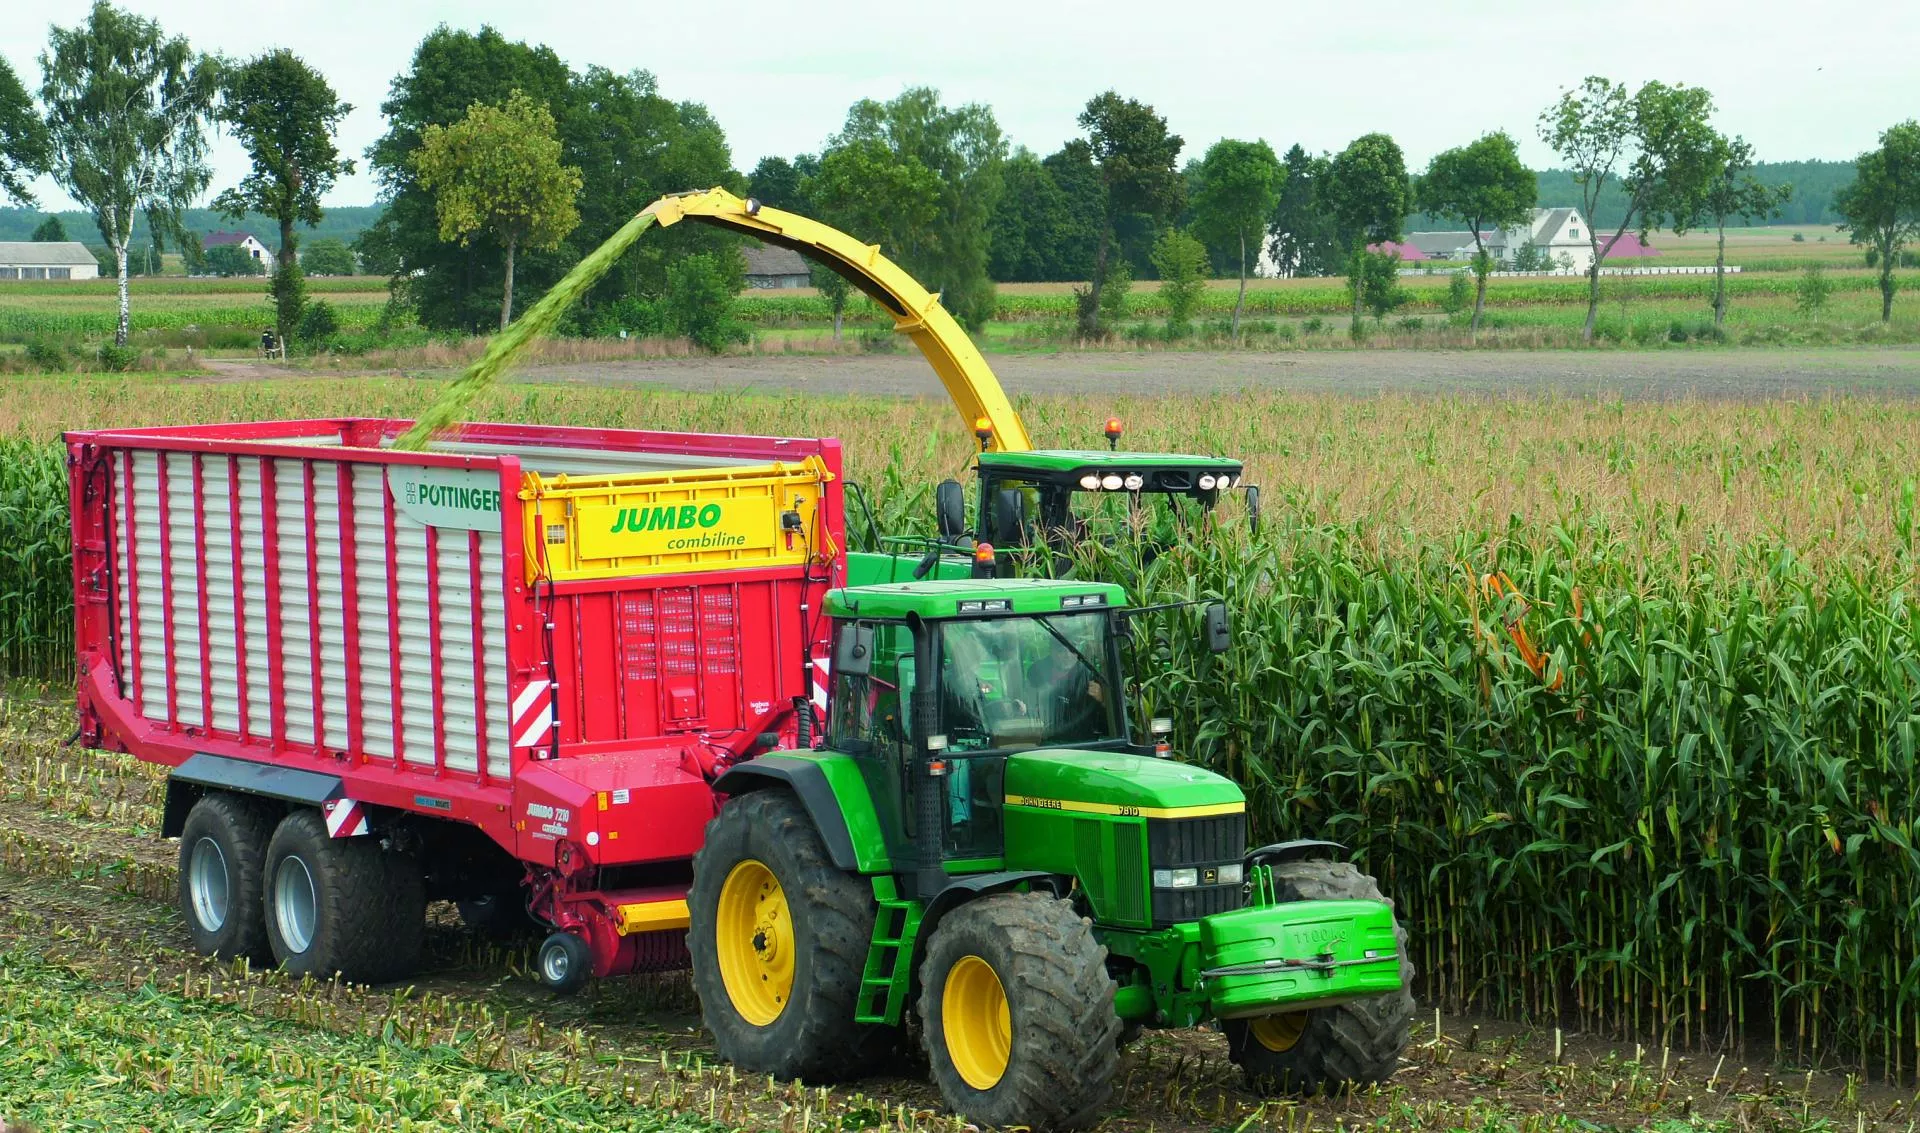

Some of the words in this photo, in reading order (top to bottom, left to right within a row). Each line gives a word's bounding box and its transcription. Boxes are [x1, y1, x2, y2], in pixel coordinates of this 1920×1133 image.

[610, 503, 721, 533] JUMBO
[667, 531, 745, 551] combiline
[527, 803, 553, 819] JUMBO
[1021, 797, 1038, 807] JOHN
[1039, 799, 1061, 809] DEERE
[1119, 806, 1139, 816] 7810
